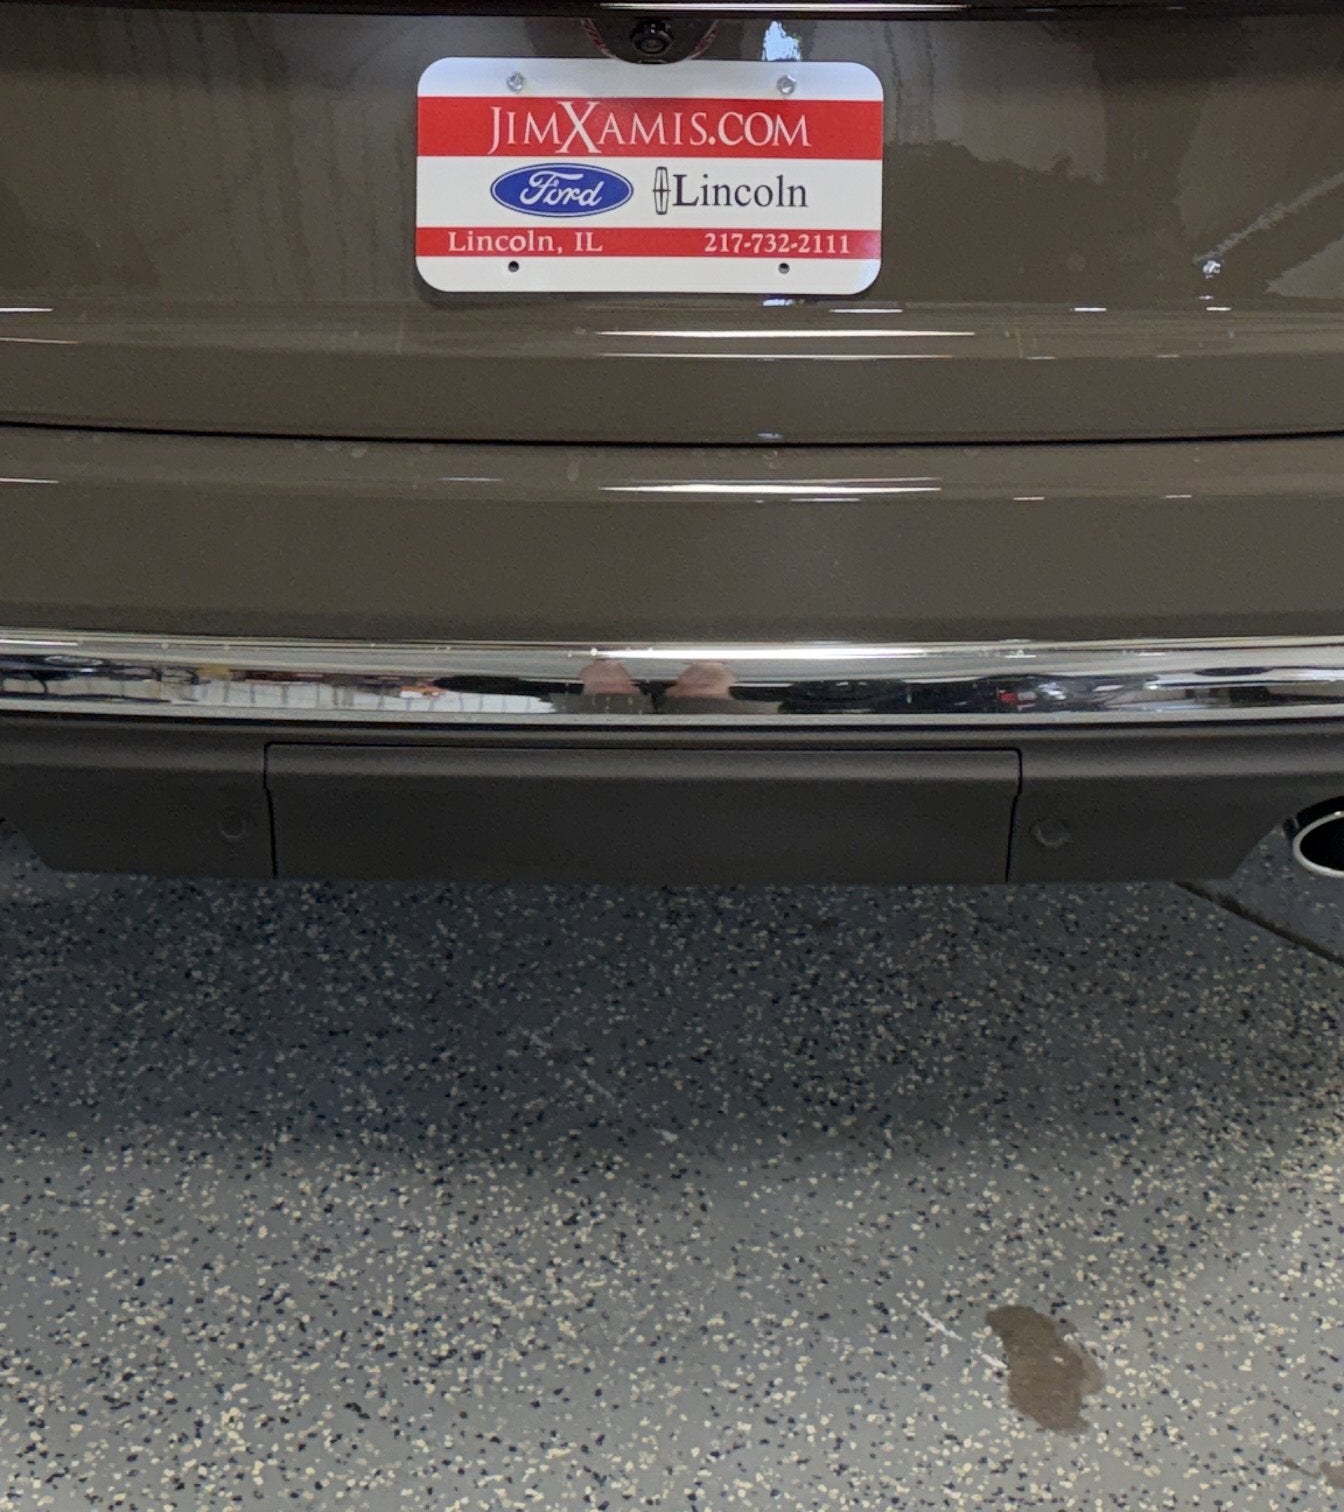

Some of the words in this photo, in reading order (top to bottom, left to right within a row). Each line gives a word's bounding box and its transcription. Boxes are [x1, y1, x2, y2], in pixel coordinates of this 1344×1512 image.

[488, 101, 811, 155] JIMXAMIS.COM
[519, 170, 602, 207] Ford
[673, 173, 808, 208] Lincoln
[448, 231, 563, 255] Lincoln,
[575, 231, 602, 252] IL
[704, 232, 849, 254] 217-732-2111
